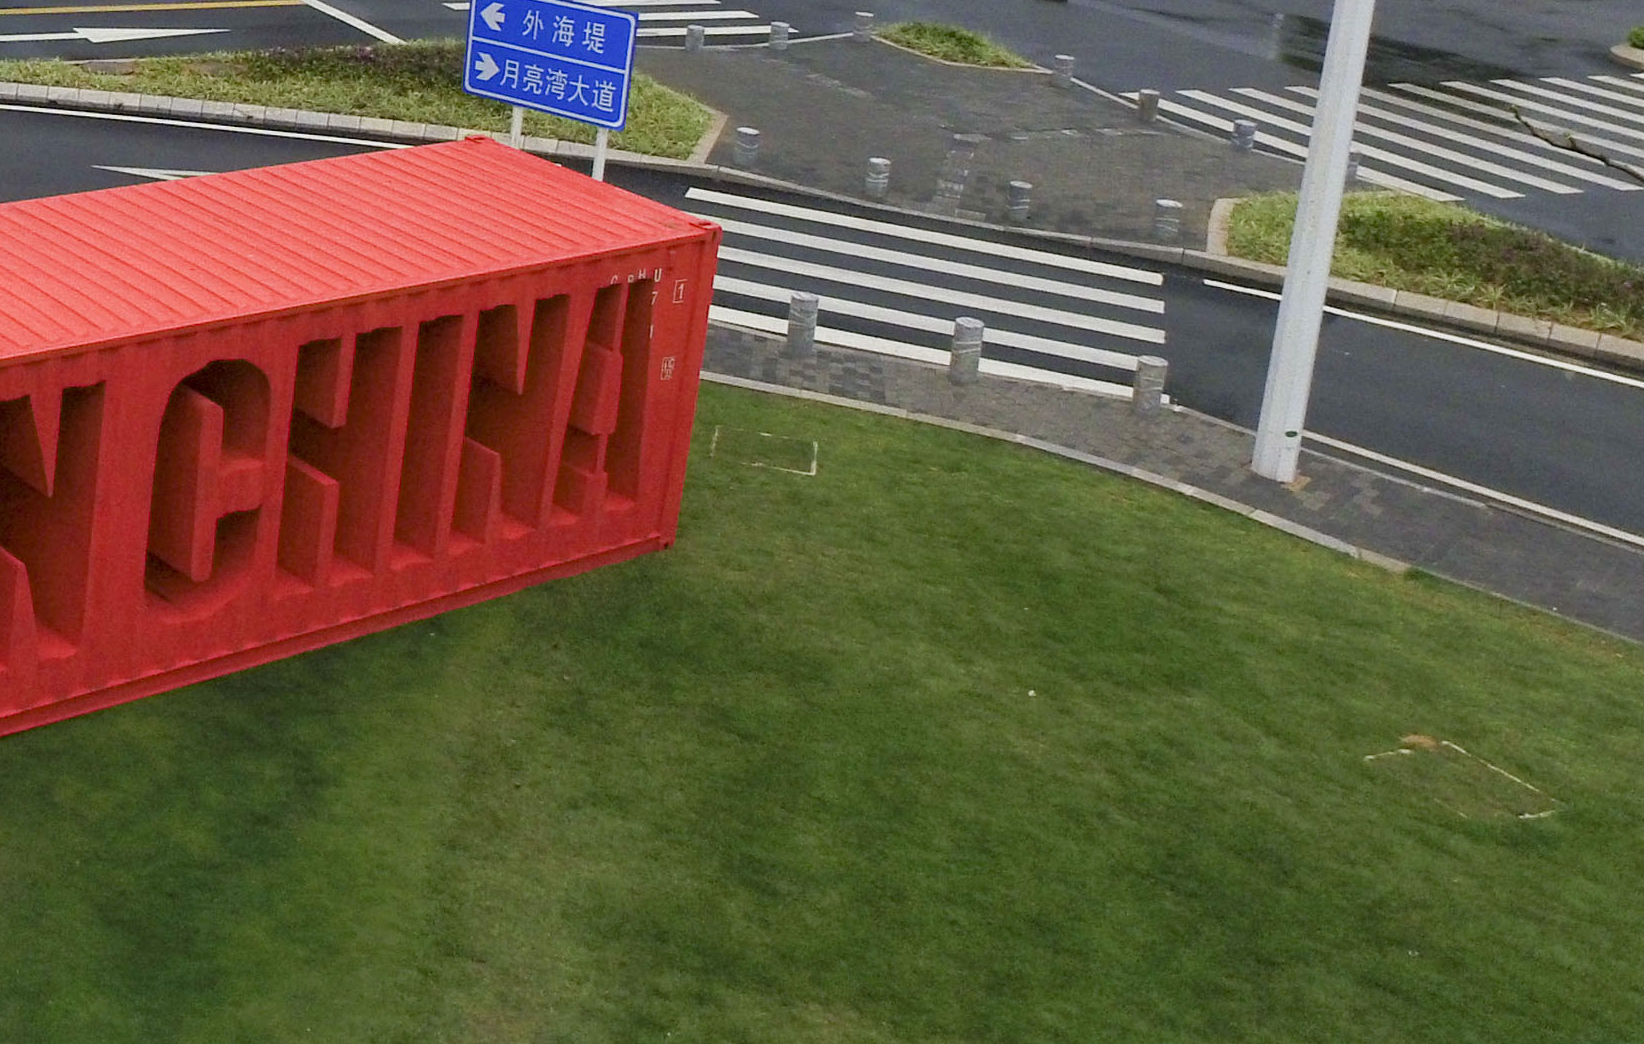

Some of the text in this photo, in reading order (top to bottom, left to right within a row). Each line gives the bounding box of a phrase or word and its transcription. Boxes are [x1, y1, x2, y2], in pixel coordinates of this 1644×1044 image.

[521, 9, 606, 54] 外海堤
[499, 59, 617, 113] 月亮湾大道
[142, 278, 656, 623] CHINA
